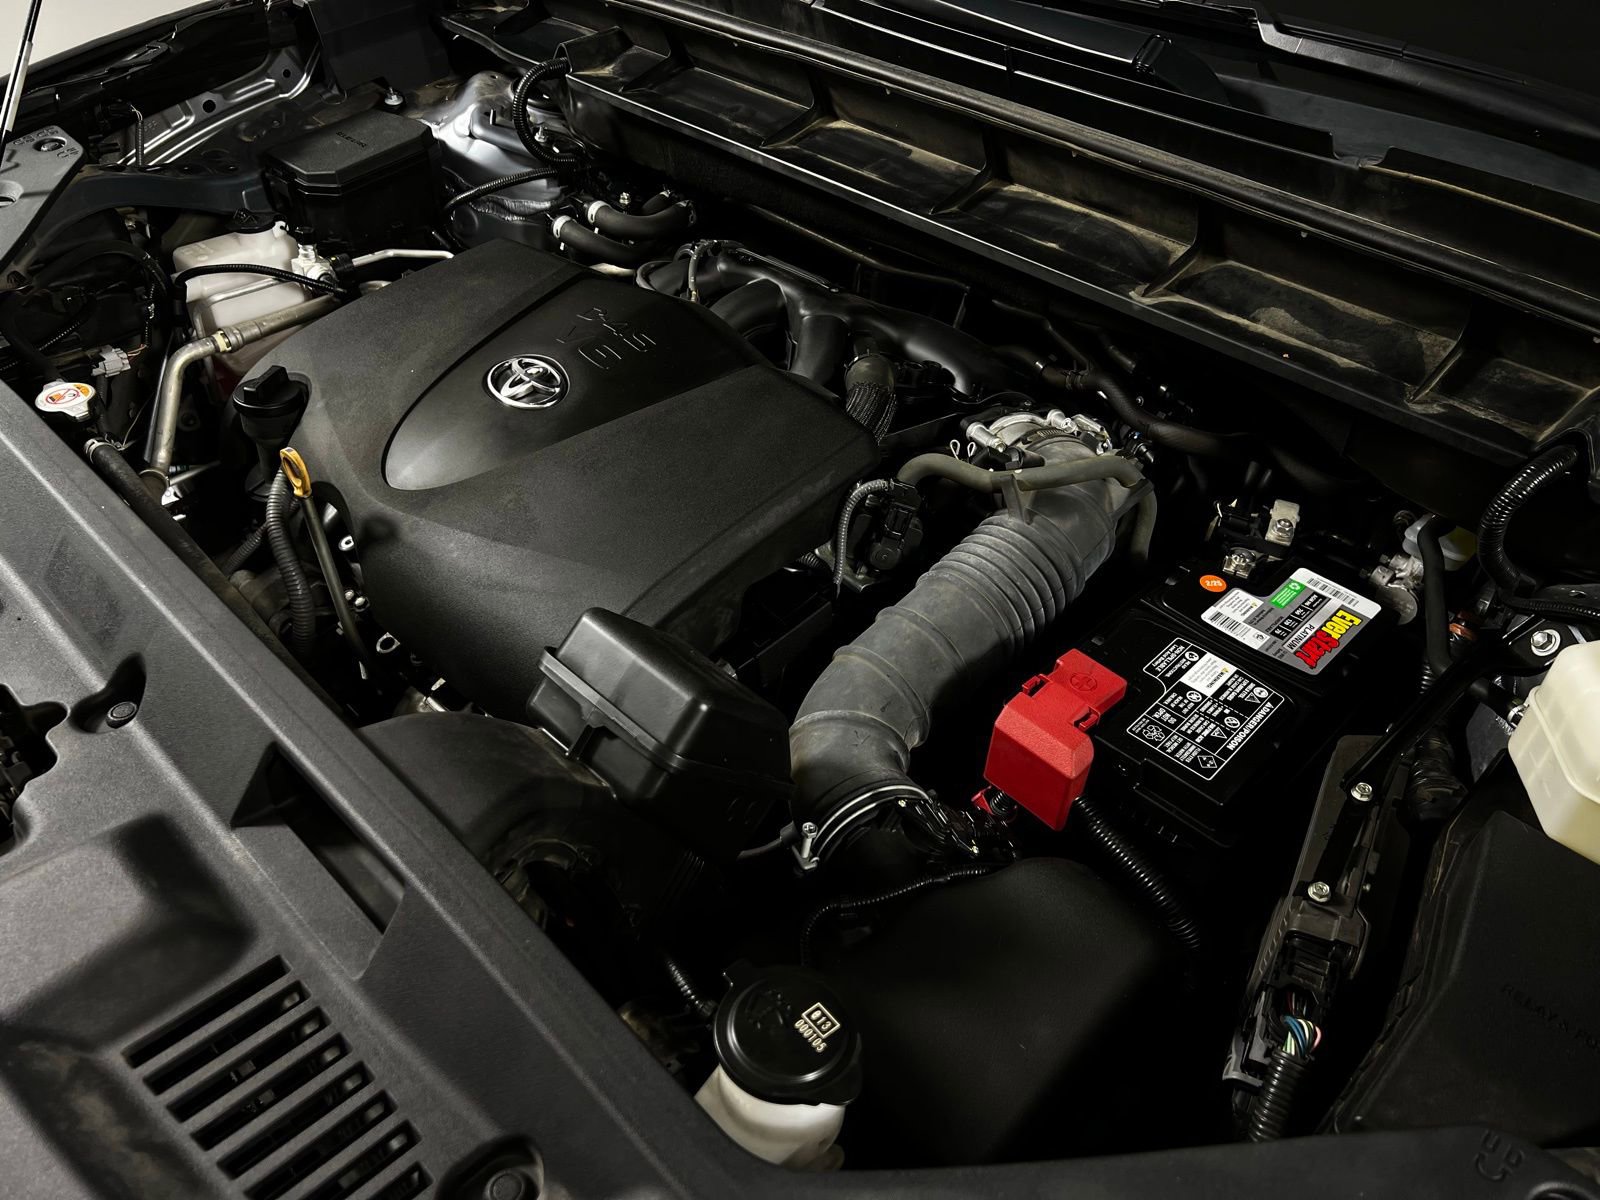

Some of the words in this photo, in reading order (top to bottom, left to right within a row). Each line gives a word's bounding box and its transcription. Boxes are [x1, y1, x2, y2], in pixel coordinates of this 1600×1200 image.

[1285, 623, 1316, 650] PLATINUM
[1290, 607, 1363, 669] EverStart
[1225, 706, 1270, 750] DANGER/POISON
[794, 1019, 828, 1052] 000105
